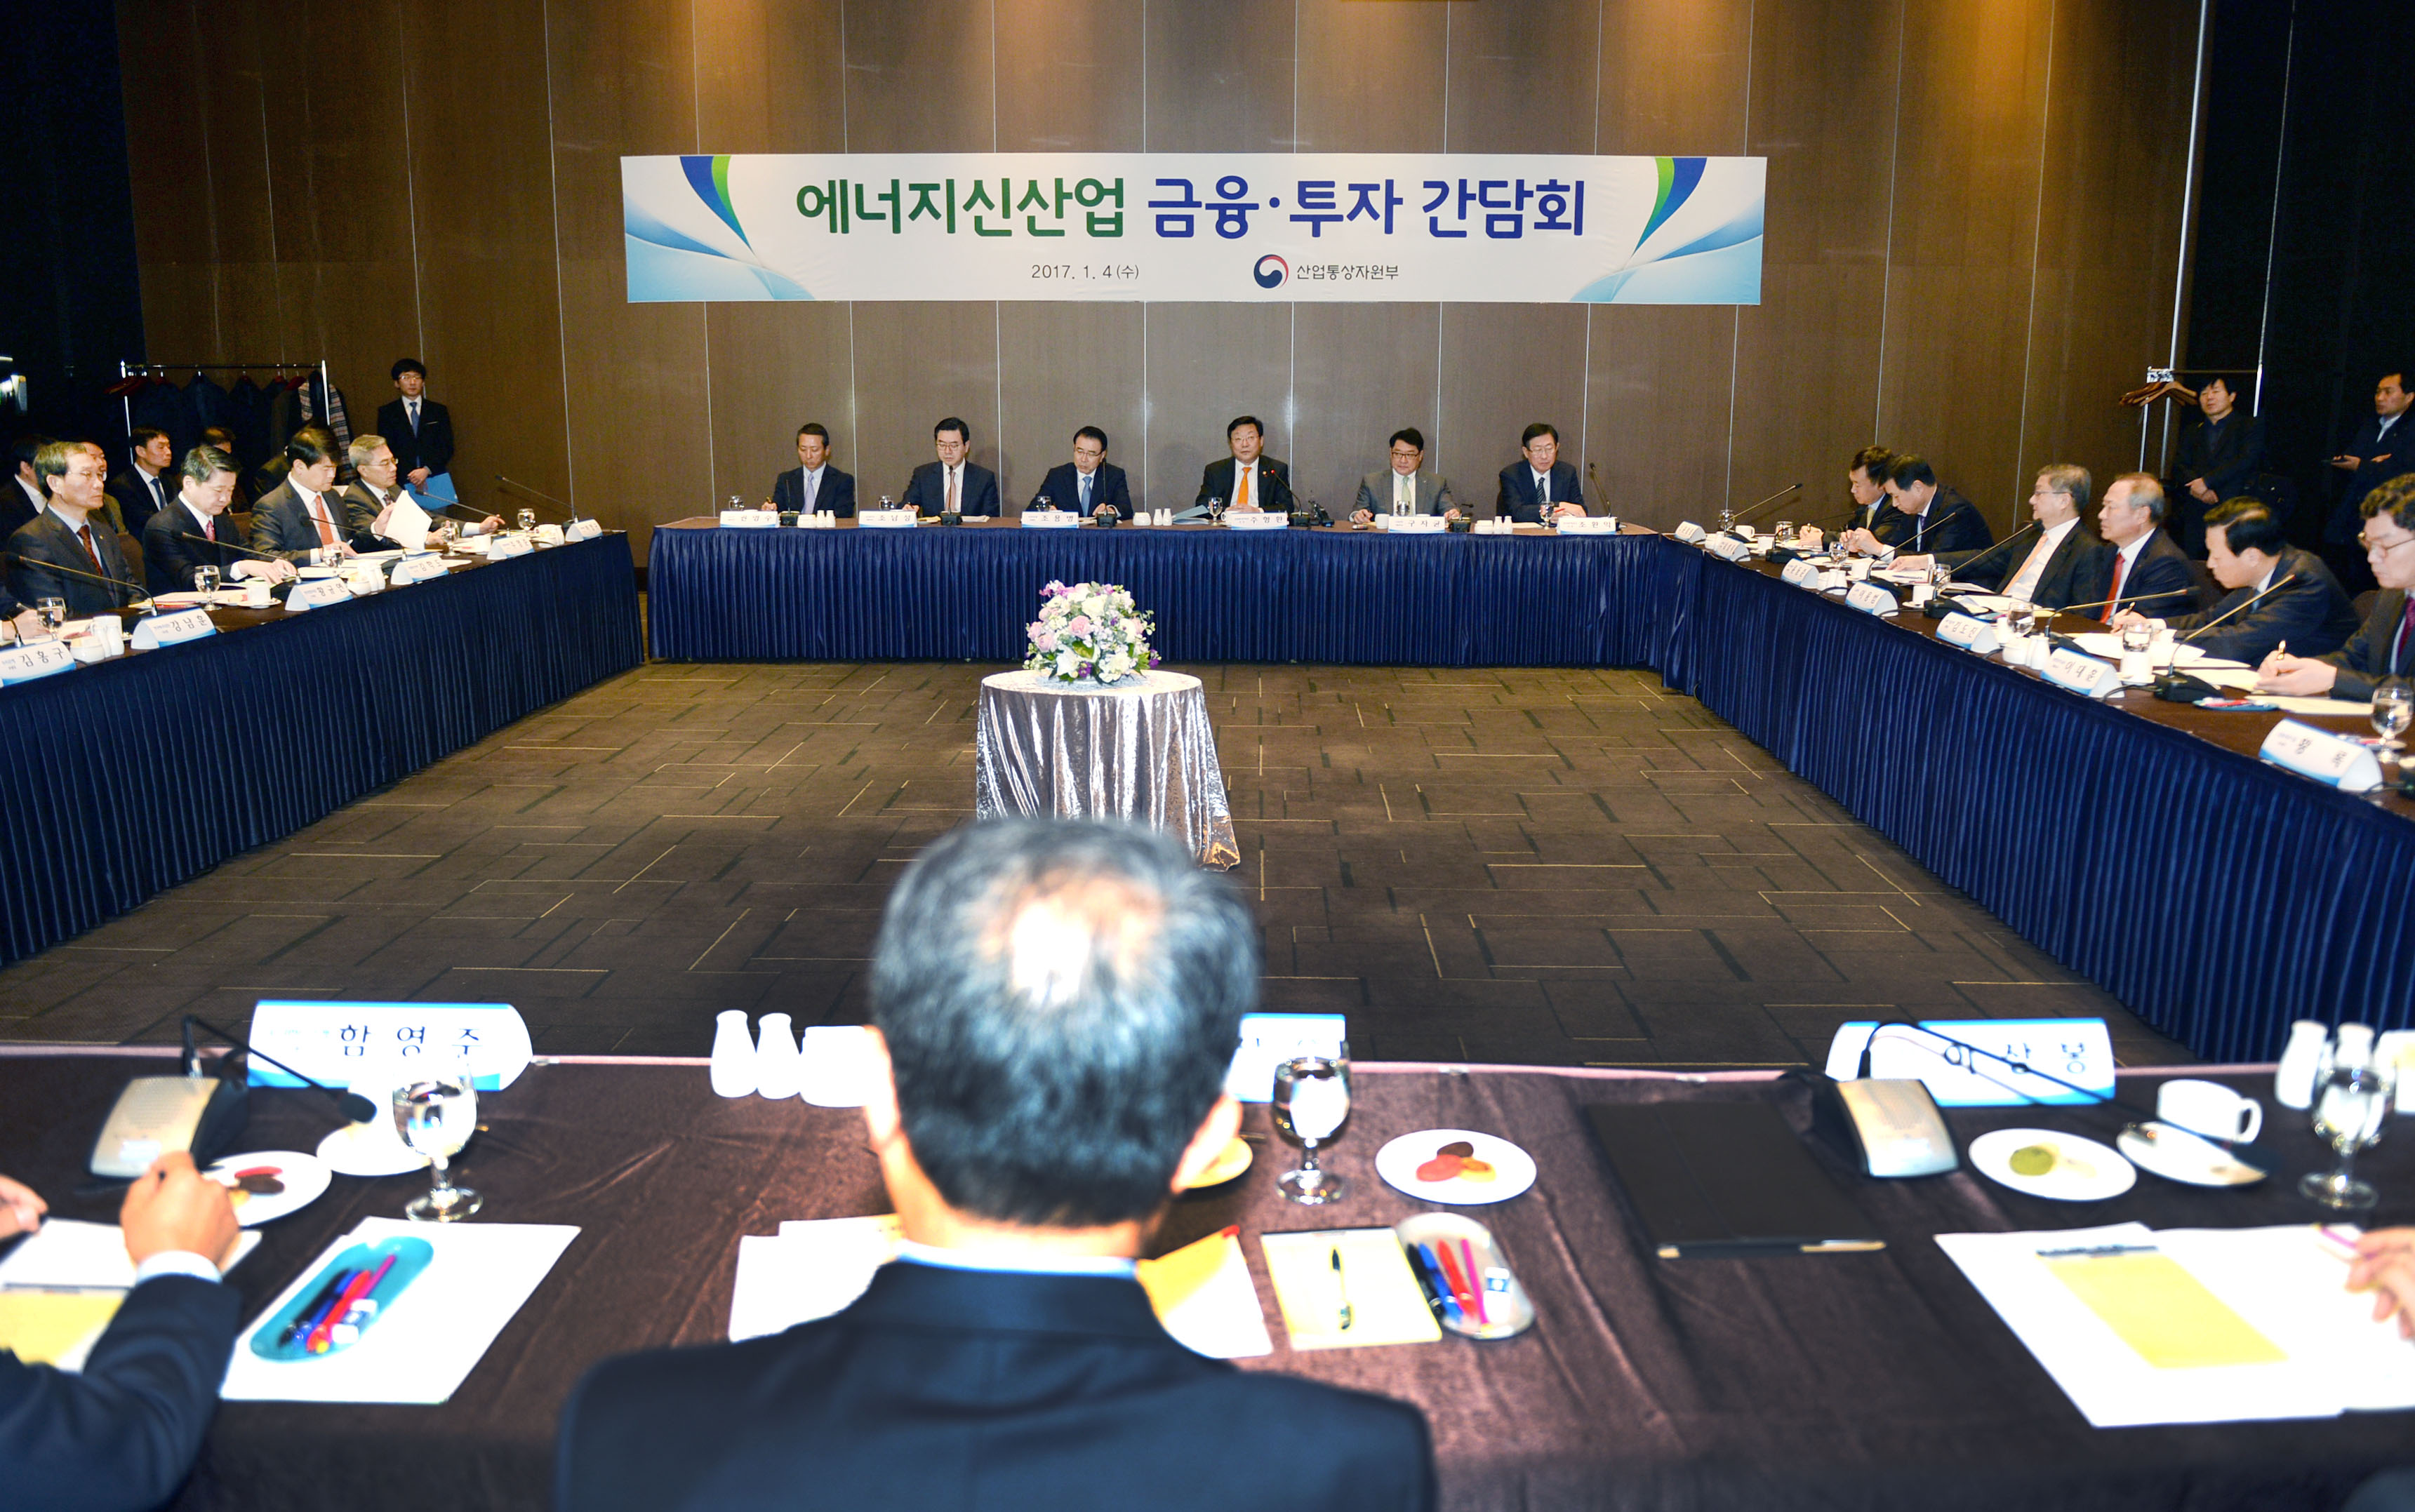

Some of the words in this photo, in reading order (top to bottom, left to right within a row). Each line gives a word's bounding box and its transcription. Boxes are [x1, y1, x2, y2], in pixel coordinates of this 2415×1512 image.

[797, 178, 1124, 237] 에너지신산업
[1423, 178, 1585, 239] 간담회
[1298, 265, 1399, 281] 산업통상자원부
